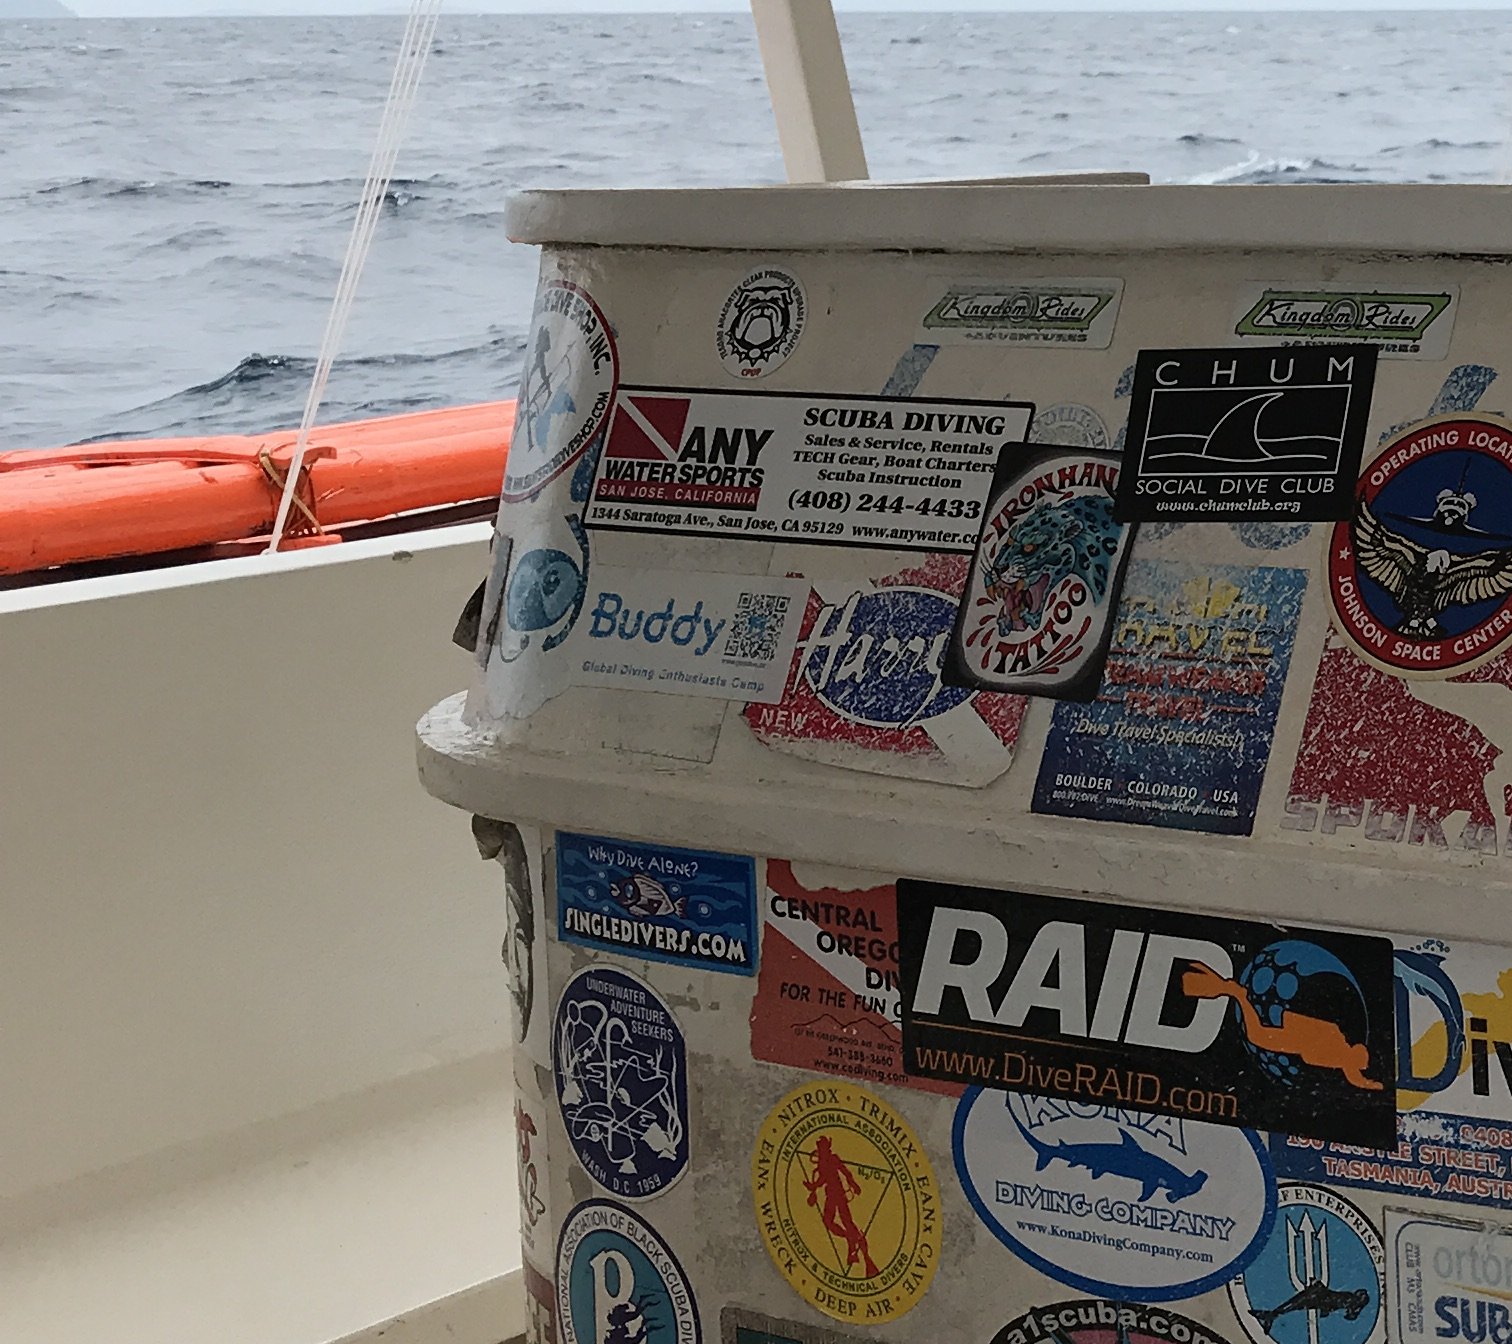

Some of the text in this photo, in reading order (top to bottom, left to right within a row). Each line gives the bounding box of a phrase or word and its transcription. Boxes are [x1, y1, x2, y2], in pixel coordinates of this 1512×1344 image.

[941, 296, 1086, 325] Kingdom Rides
[1256, 302, 1417, 330] Kingdom Rides
[1156, 356, 1354, 386] CHUM
[803, 407, 894, 431] SCUBA
[902, 411, 1006, 436] DIVING
[677, 426, 775, 466] ANY
[793, 450, 998, 473] TECH Gear, Boat Charters
[804, 434, 993, 455] Sales & Service, Rentals
[1370, 430, 1459, 486] OPERATING
[598, 483, 757, 504] SAN CALIFORNIA
[817, 468, 962, 489] Scuba Instruction
[1135, 477, 1336, 495] SOCIAL DIVE CLUB
[591, 506, 845, 535] 1344 Saratoga San Jose, CA 95129
[788, 489, 981, 520] (408) 244-4433
[1156, 499, 1301, 514] www.chumclub.org
[589, 591, 726, 657] Buddy
[993, 582, 1087, 674] TATTOO
[1338, 574, 1388, 648] JOHNSON
[1391, 641, 1441, 661] SPACE
[582, 660, 654, 680] Global Diving
[1076, 718, 1155, 741] Dive Travel
[1055, 773, 1239, 805] BOULDER COLORADO USA
[770, 895, 883, 932] CENTRAL
[564, 907, 747, 963] SINGLEDIVERS.COM
[586, 976, 646, 1005] UNDERWATER
[911, 906, 1234, 1054] RAID
[610, 1001, 666, 1026] ADVENTURE
[780, 982, 887, 1016] FOR THE FUN
[631, 1020, 675, 1043] SEEKERS
[916, 1044, 1239, 1119] www.DiveRAID.com
[777, 1088, 917, 1159] NITROX TRIMIX
[580, 1149, 607, 1184] WASH
[782, 1113, 912, 1193] INTERNATIONAL ASSOCIATION
[1420, 1144, 1506, 1177] STREET,
[1322, 1156, 1440, 1194] TASMANIA,
[609, 1212, 626, 1229] OF
[995, 1179, 1236, 1242] DIVING COMPANY
[563, 1211, 609, 1264] ASSOCIATION
[626, 1223, 662, 1267] BLACK
[783, 1217, 910, 1293] NITROX TECHNICAL DIVERS
[1016, 1218, 1214, 1264] www.KonaDivingCompany.com
[760, 1200, 895, 1319] WRECK DEEP AIR
[901, 1242, 934, 1296] CAVE
[558, 1264, 575, 1343] NATIONAL
[660, 1260, 688, 1318] SCUBA
